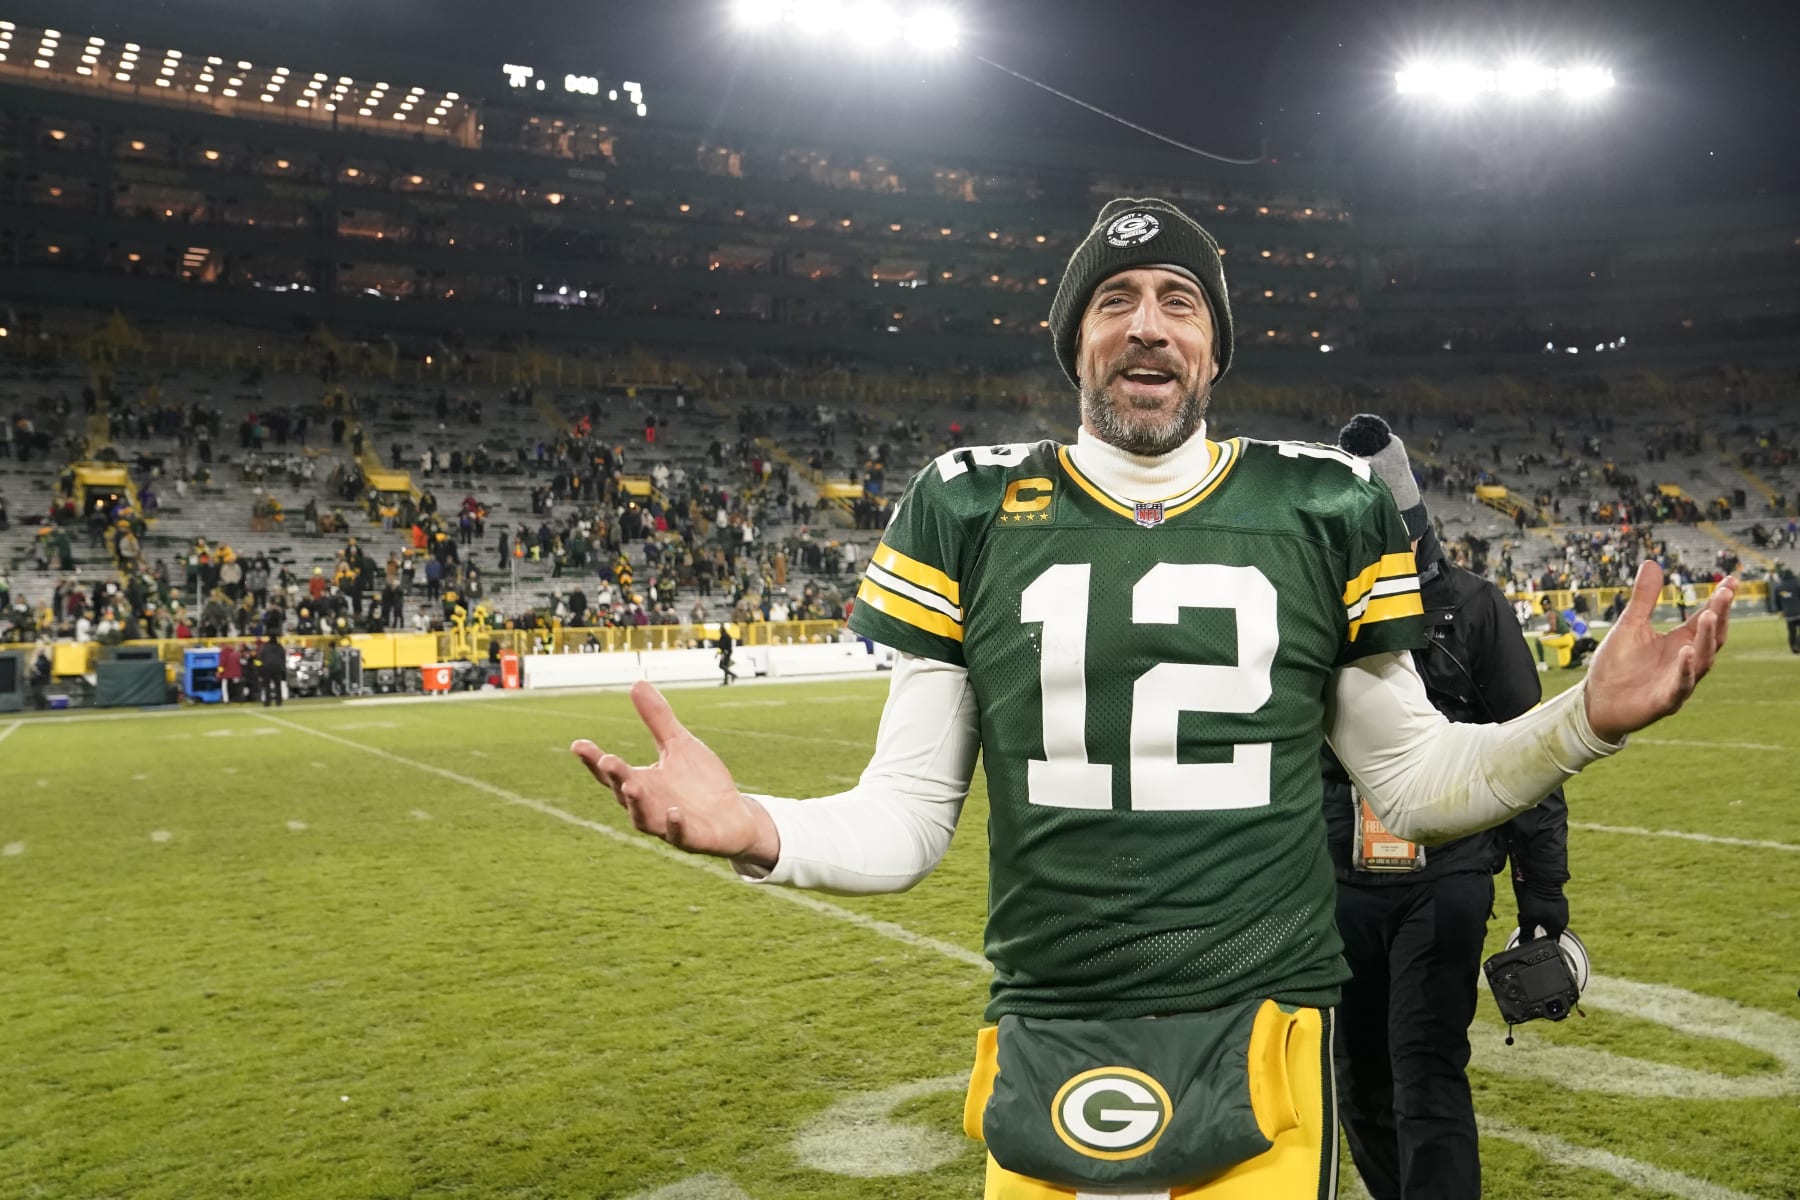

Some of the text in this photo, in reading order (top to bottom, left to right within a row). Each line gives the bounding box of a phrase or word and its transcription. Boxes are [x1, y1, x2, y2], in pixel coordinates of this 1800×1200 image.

[1002, 477, 1054, 513] C
[1137, 509, 1161, 522] NFL
[1020, 562, 1279, 811] 12
[1063, 1078, 1159, 1147] G
